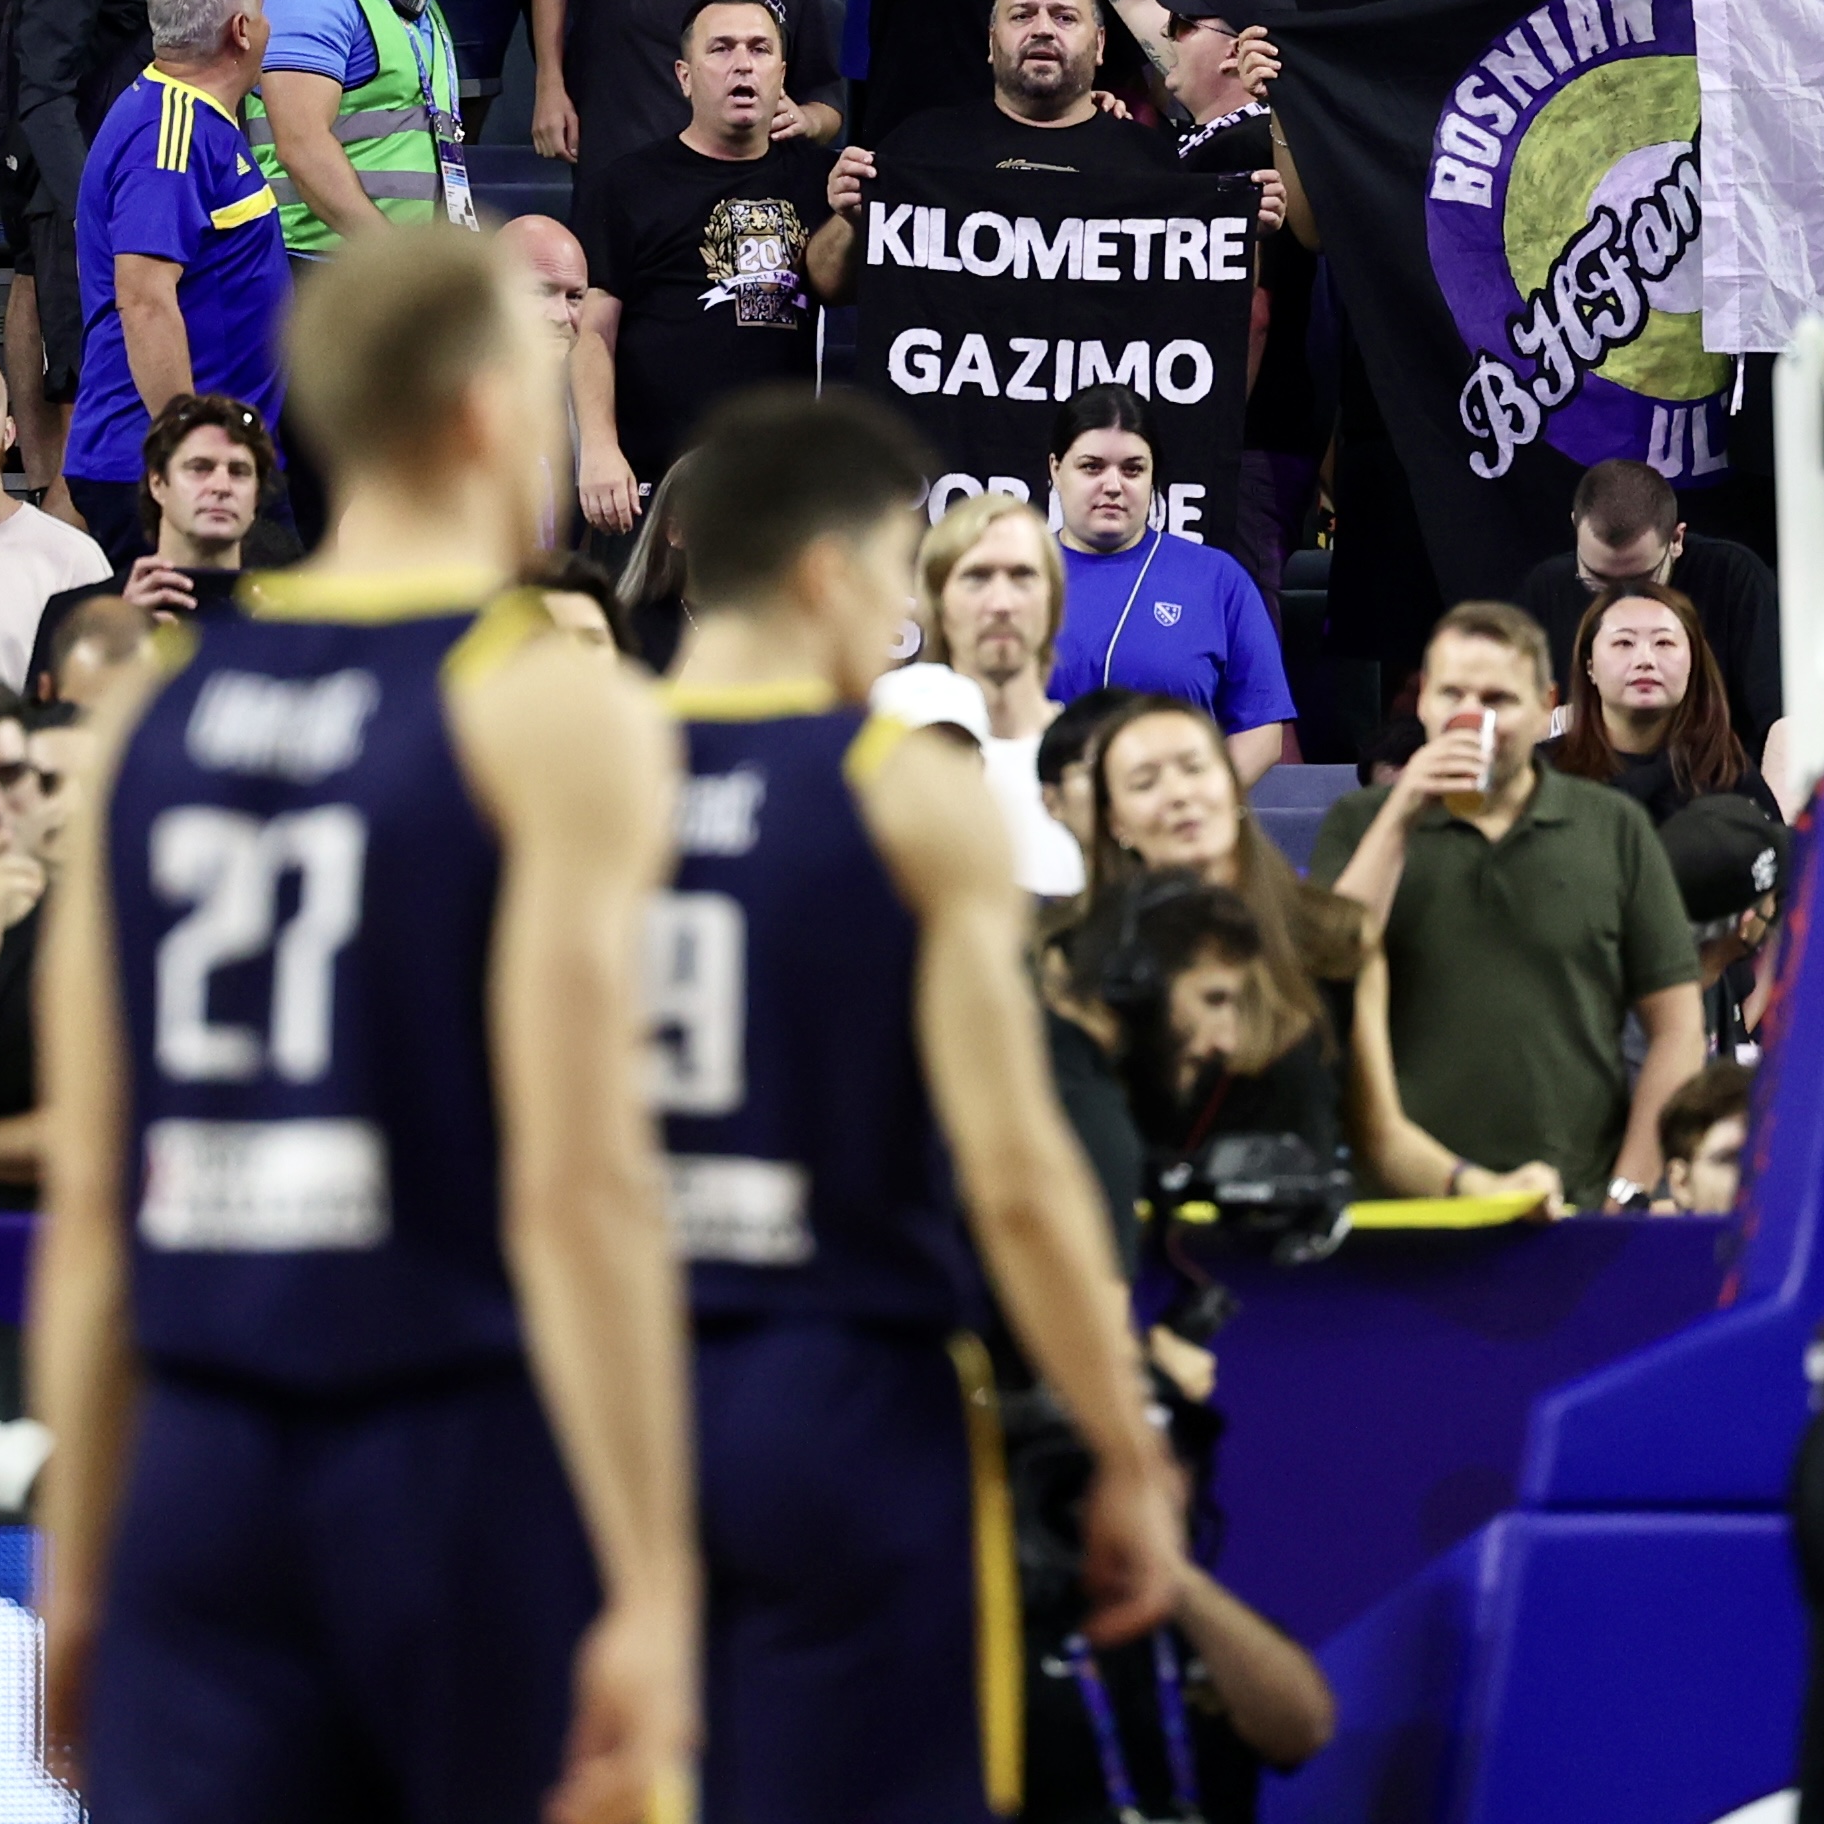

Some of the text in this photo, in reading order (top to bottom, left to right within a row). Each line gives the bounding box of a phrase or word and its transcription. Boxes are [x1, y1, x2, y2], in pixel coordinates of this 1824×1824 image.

[739, 237, 782, 272] 20
[866, 202, 1249, 283] KILOMETRE
[885, 326, 1215, 405] GAZIMO
[1646, 402, 1730, 479] UL
[147, 803, 369, 1087] 27
